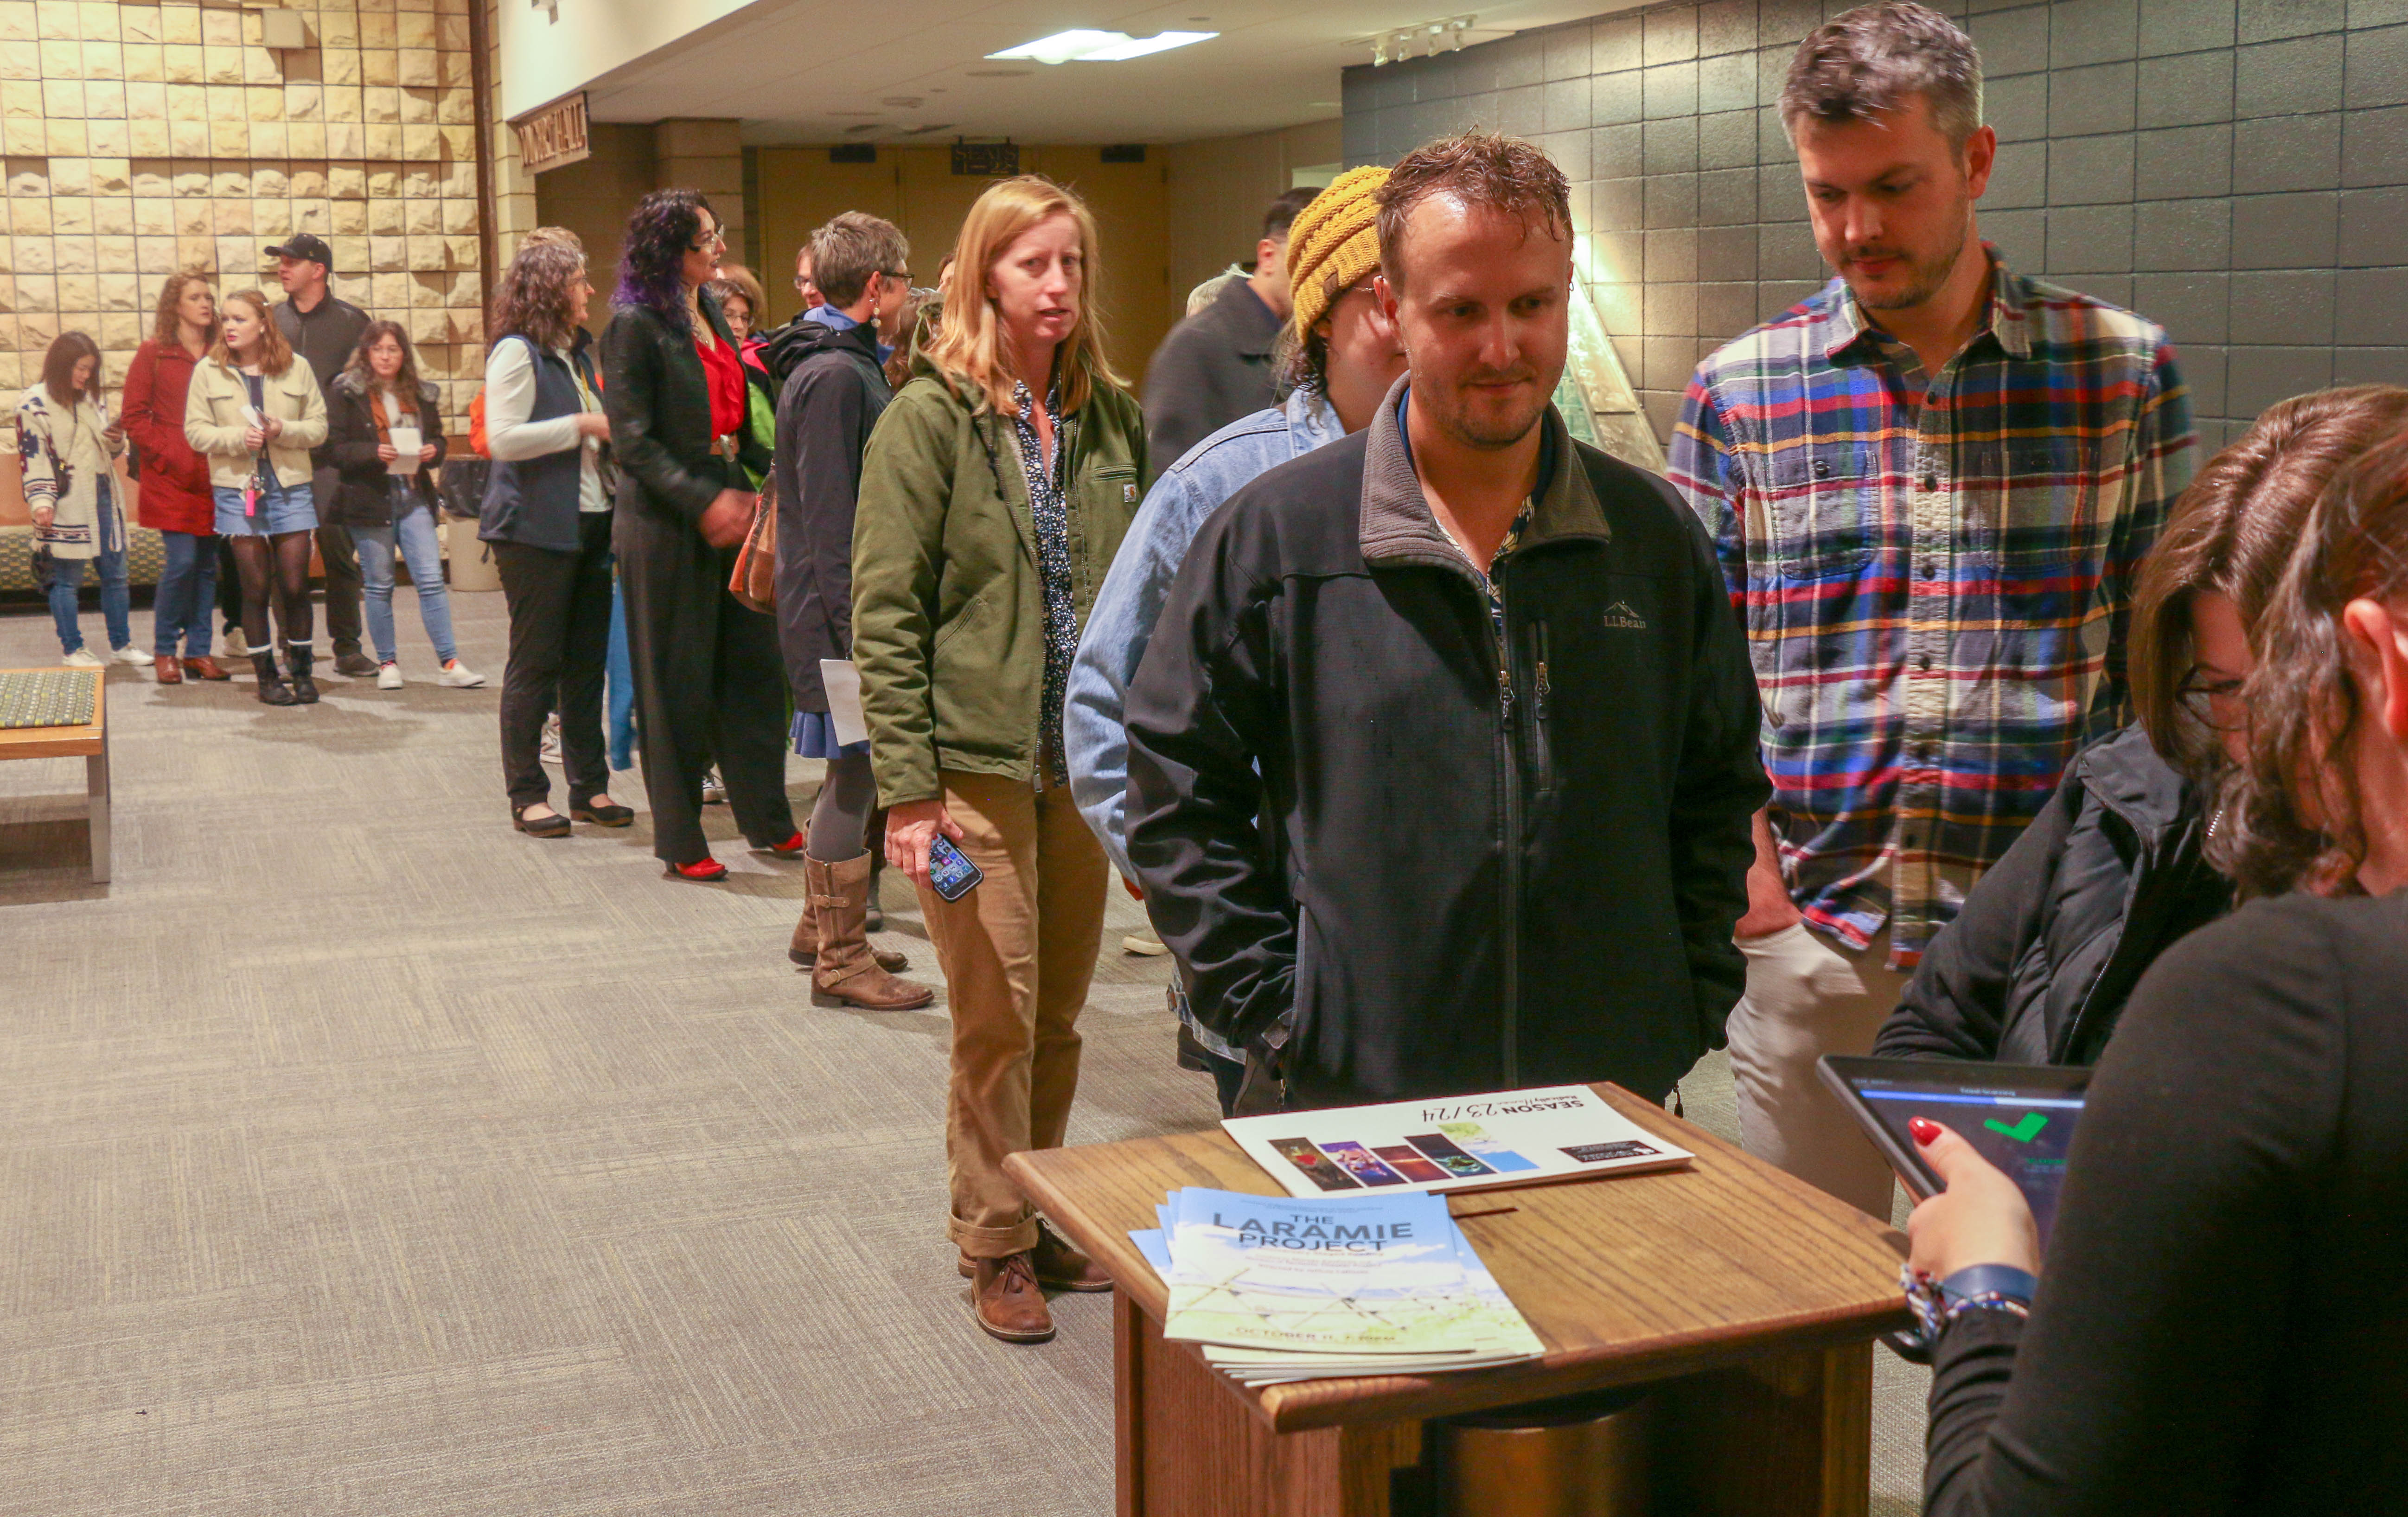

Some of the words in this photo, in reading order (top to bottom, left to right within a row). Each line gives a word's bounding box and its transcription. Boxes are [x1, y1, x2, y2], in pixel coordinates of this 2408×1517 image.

[1501, 1100, 1584, 1114] SEASON
[1214, 1213, 1413, 1240] LARAMIE
[1291, 1215, 1334, 1225] THE
[1239, 1233, 1387, 1252] PROJECT
